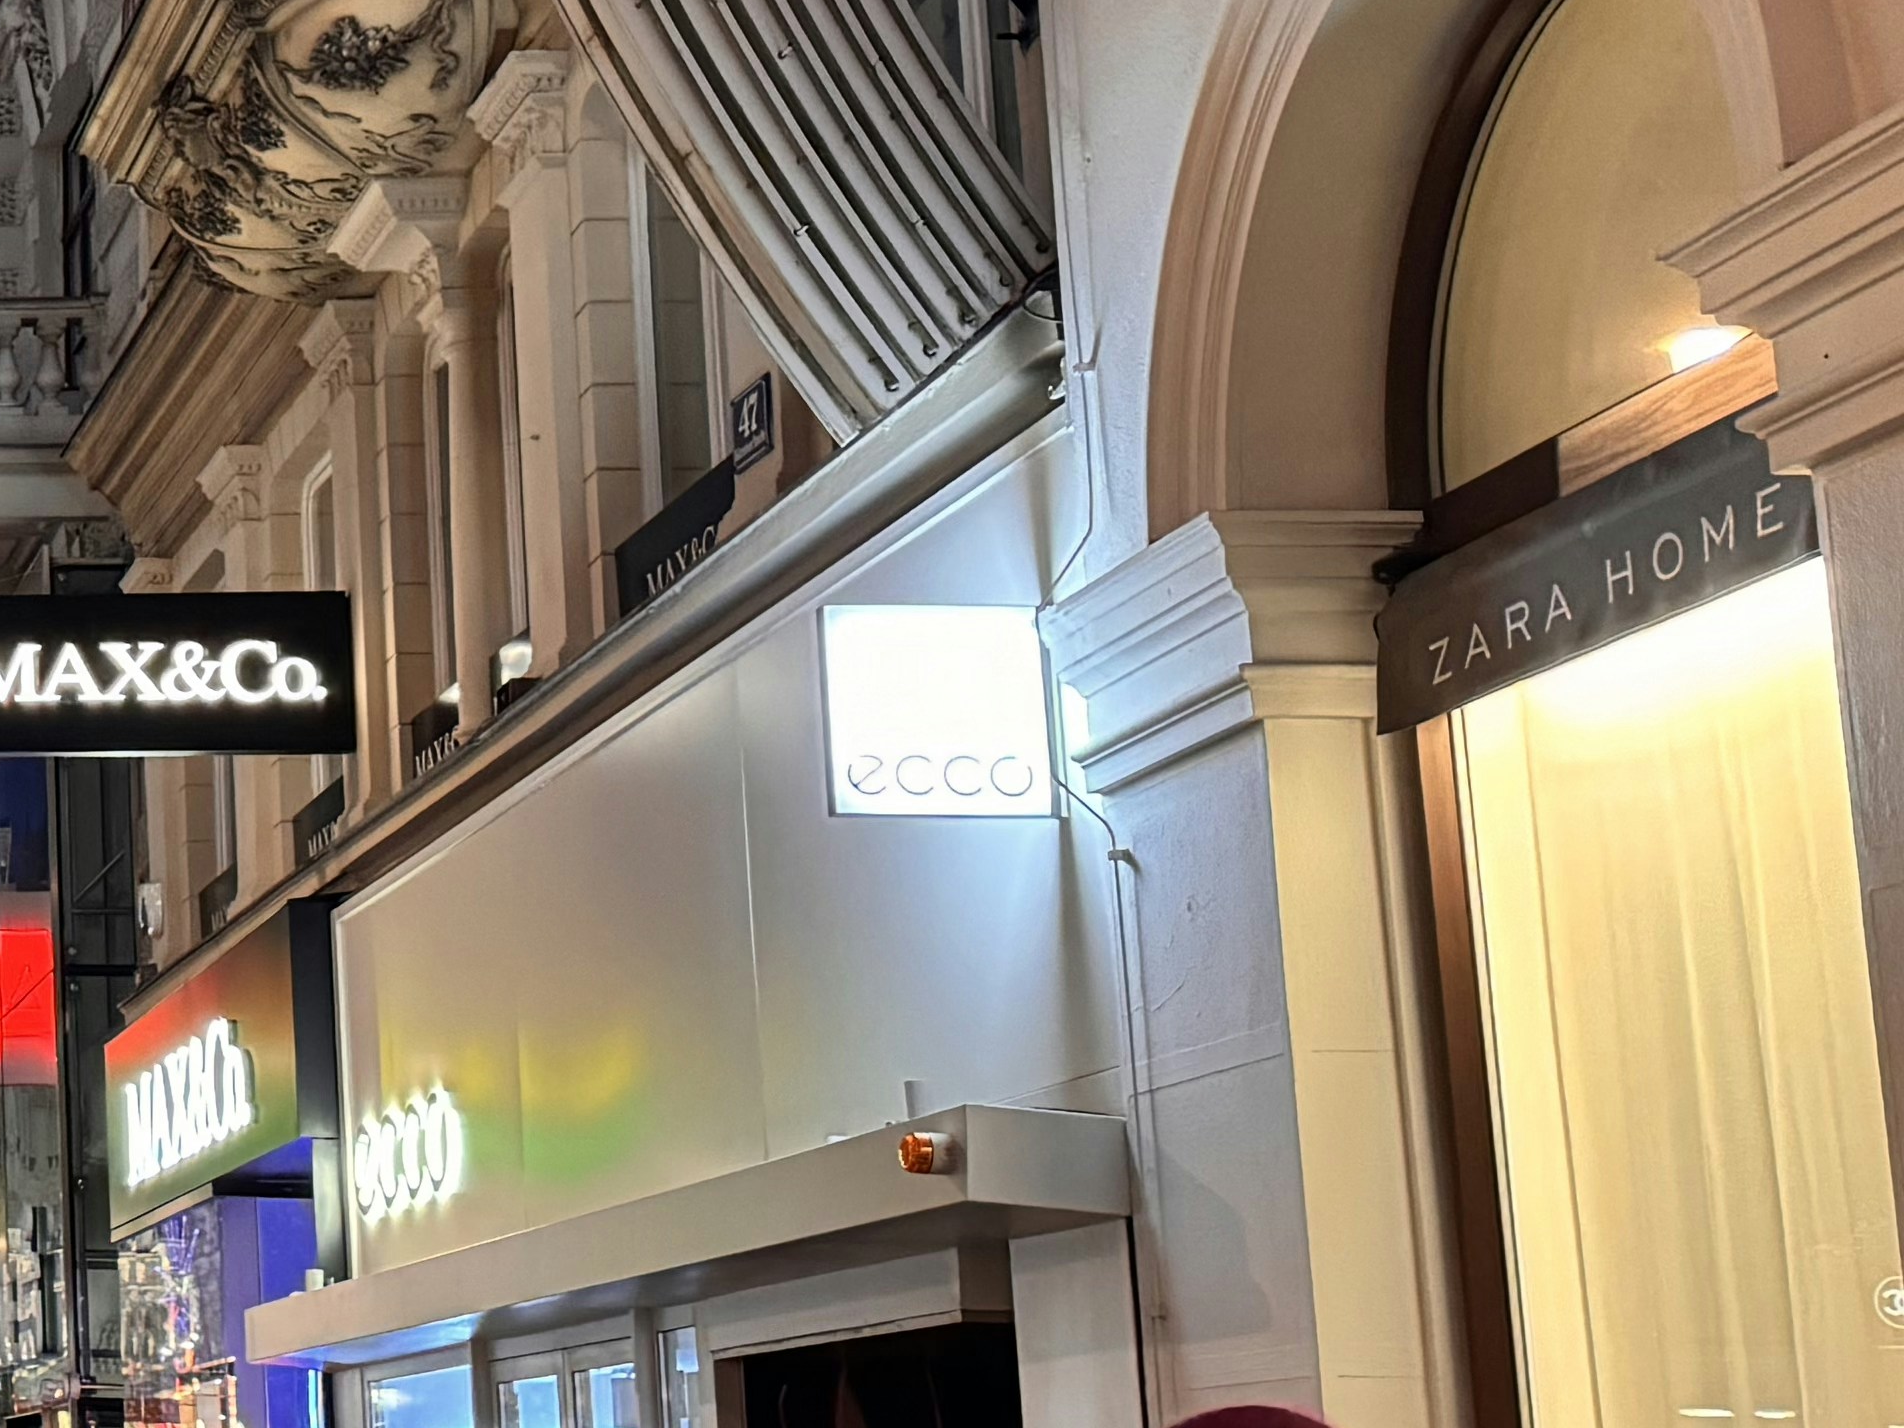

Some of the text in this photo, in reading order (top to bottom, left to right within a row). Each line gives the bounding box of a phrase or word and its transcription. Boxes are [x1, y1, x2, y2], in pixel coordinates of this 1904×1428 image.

[738, 390, 759, 439] 47
[1427, 482, 1785, 686] ZARA HOME
[847, 754, 1033, 797] ecco
